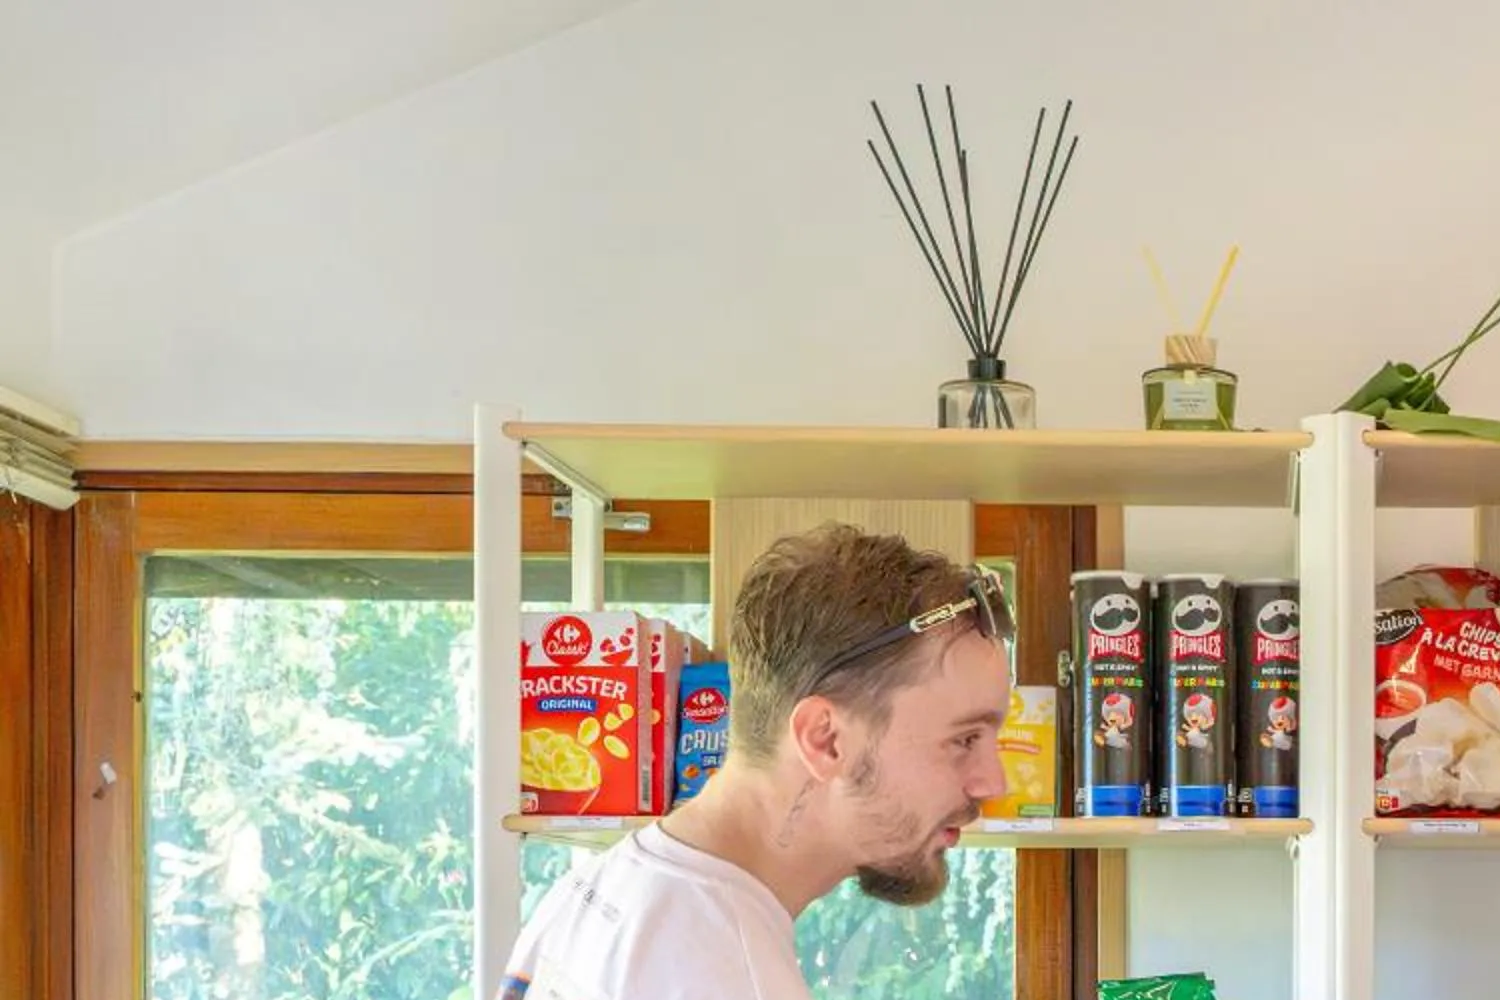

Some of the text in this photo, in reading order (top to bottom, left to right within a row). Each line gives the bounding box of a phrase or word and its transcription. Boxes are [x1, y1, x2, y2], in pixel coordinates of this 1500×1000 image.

[1375, 613, 1424, 633] sation
[1091, 635, 1140, 657] PRINGLES
[1172, 635, 1220, 657] PRINGLES
[1435, 631, 1457, 651] LA
[1434, 654, 1461, 673] MET
[518, 675, 628, 700] RACKSTER
[541, 700, 593, 711] ORIGINAL
[681, 729, 729, 755] CRUS
